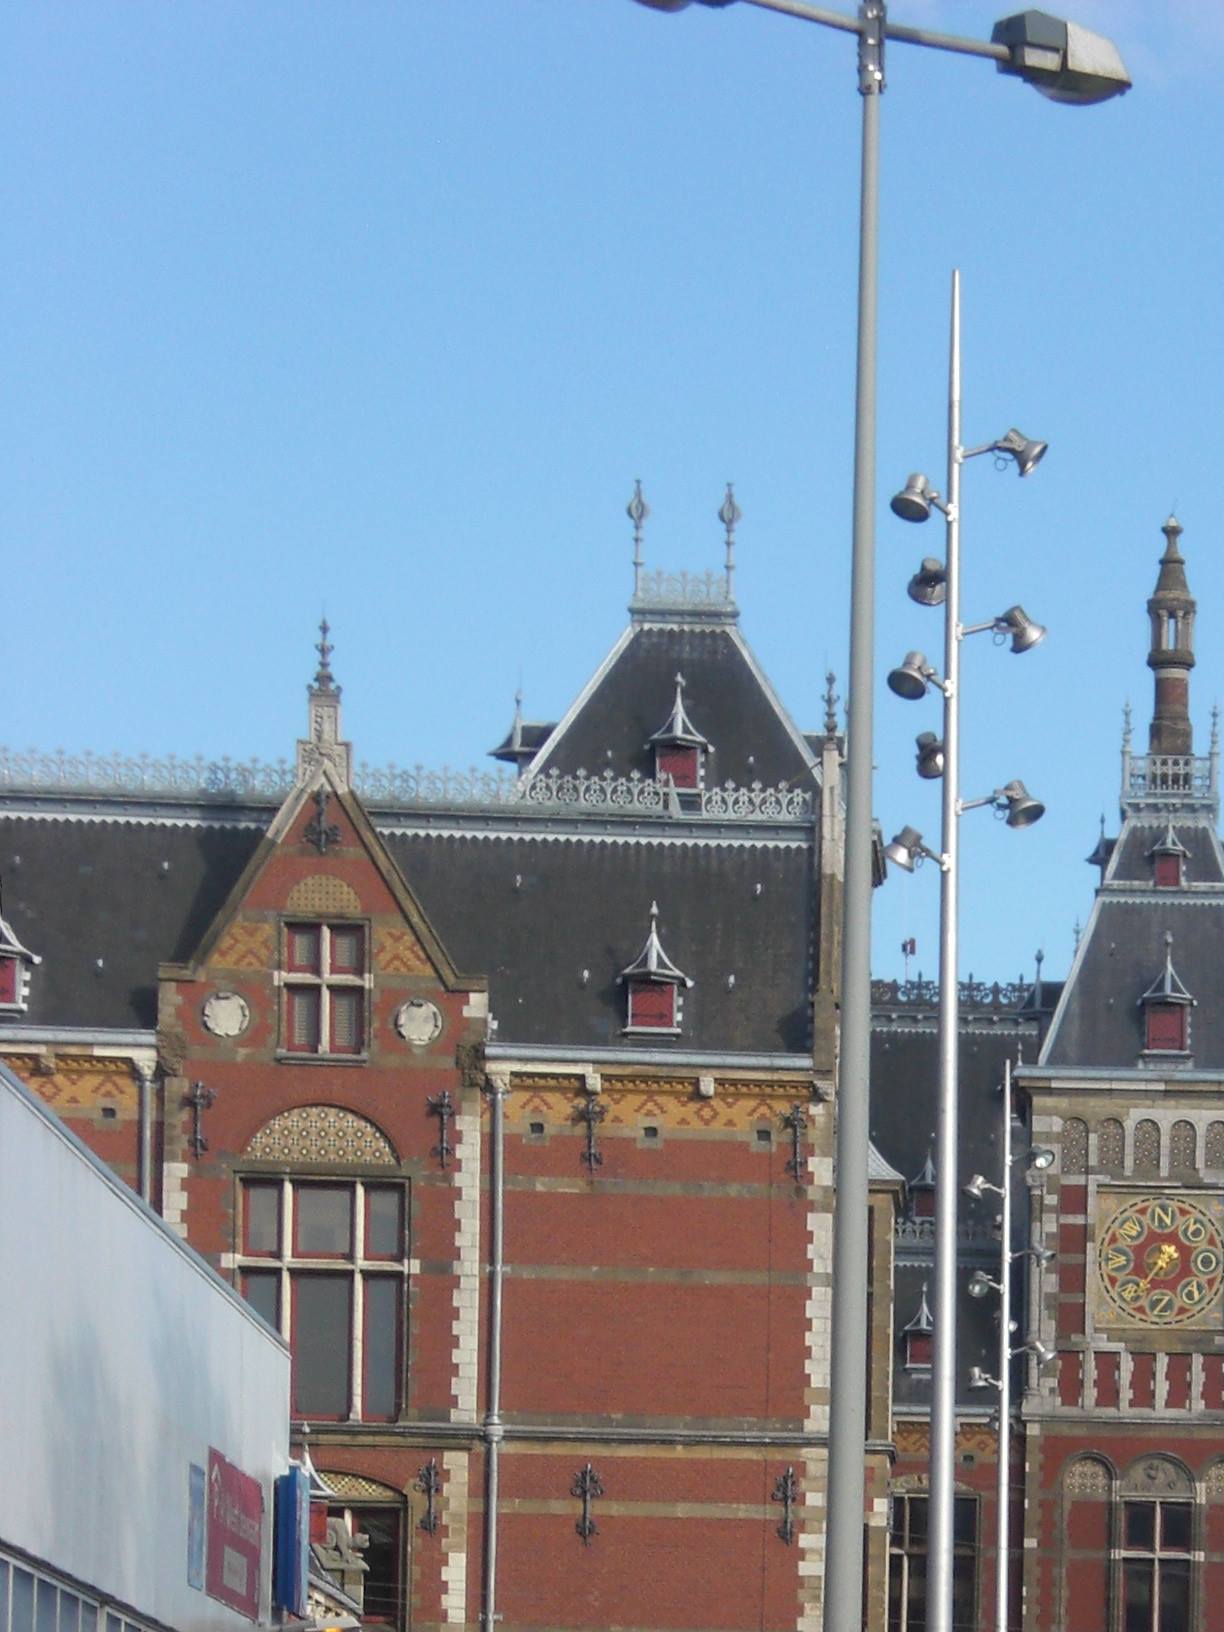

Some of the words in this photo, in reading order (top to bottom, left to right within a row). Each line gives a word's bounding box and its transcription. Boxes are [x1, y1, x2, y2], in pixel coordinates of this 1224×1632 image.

[1154, 1207, 1172, 1226] N
[1197, 1252, 1216, 1272] O
[1152, 1295, 1171, 1315] Z
